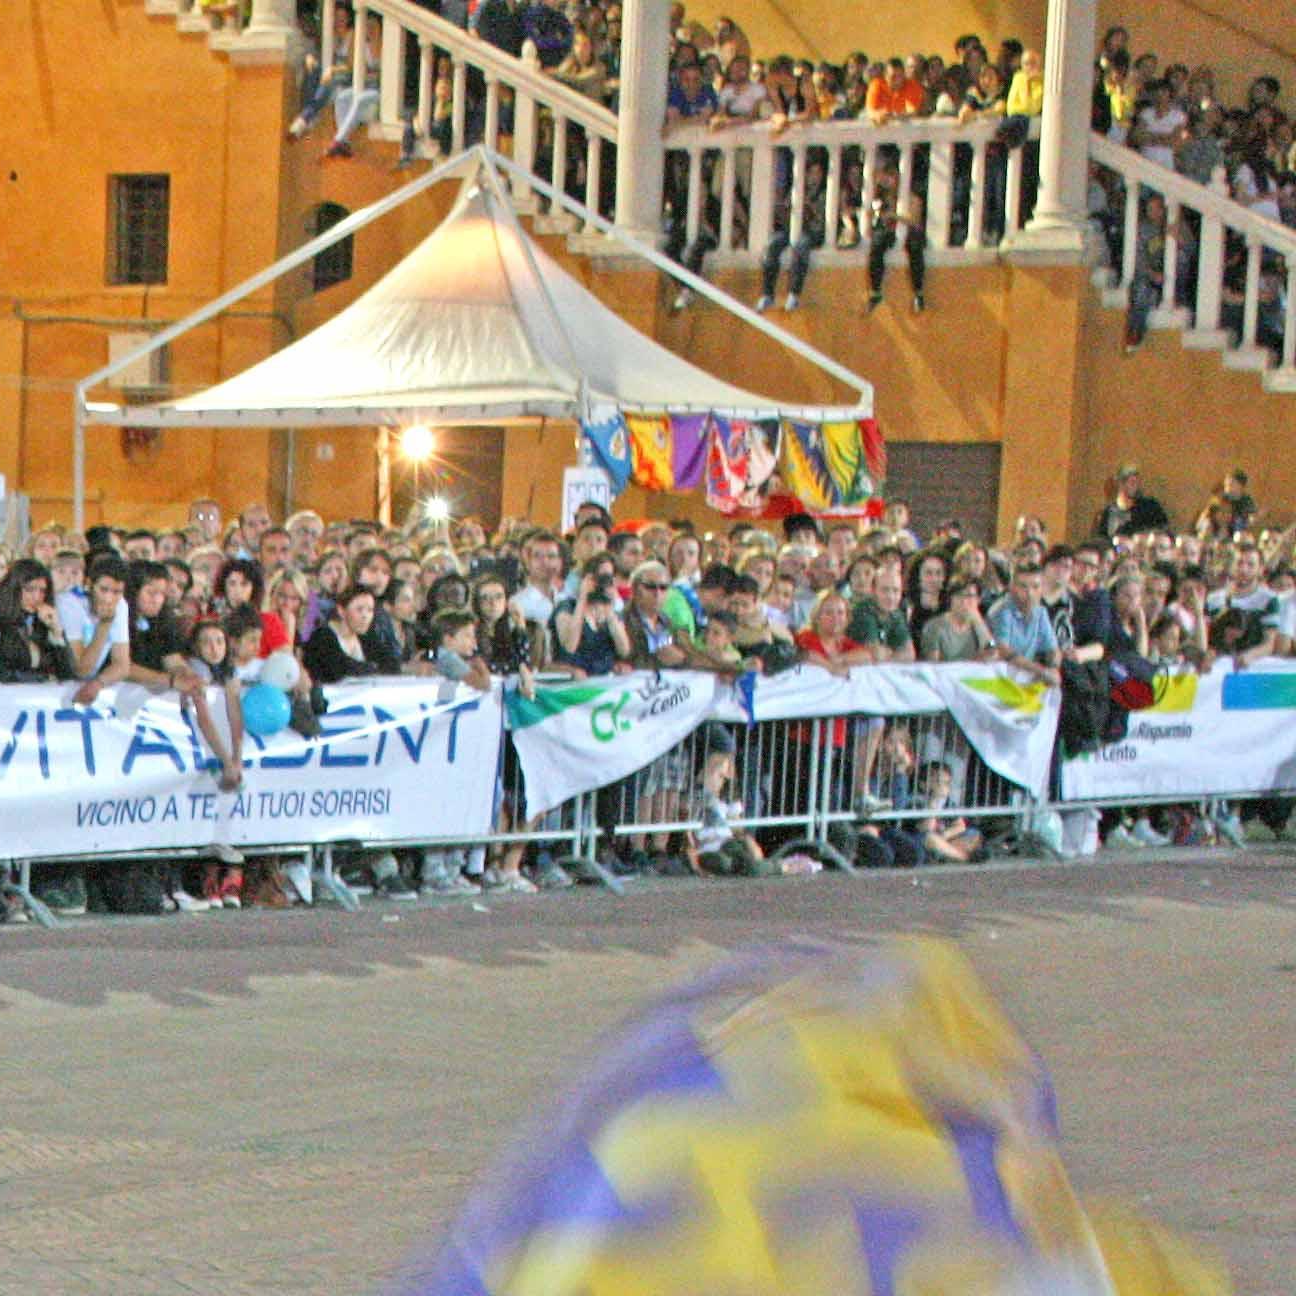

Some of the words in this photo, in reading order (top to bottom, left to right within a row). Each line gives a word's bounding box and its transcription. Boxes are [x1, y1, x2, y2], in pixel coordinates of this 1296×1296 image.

[76, 799, 156, 827] VICINO
[161, 797, 180, 823] A
[188, 796, 220, 823] TE,
[229, 794, 258, 819] AI
[261, 791, 305, 818] TUOI
[309, 788, 391, 815] SORRISI
